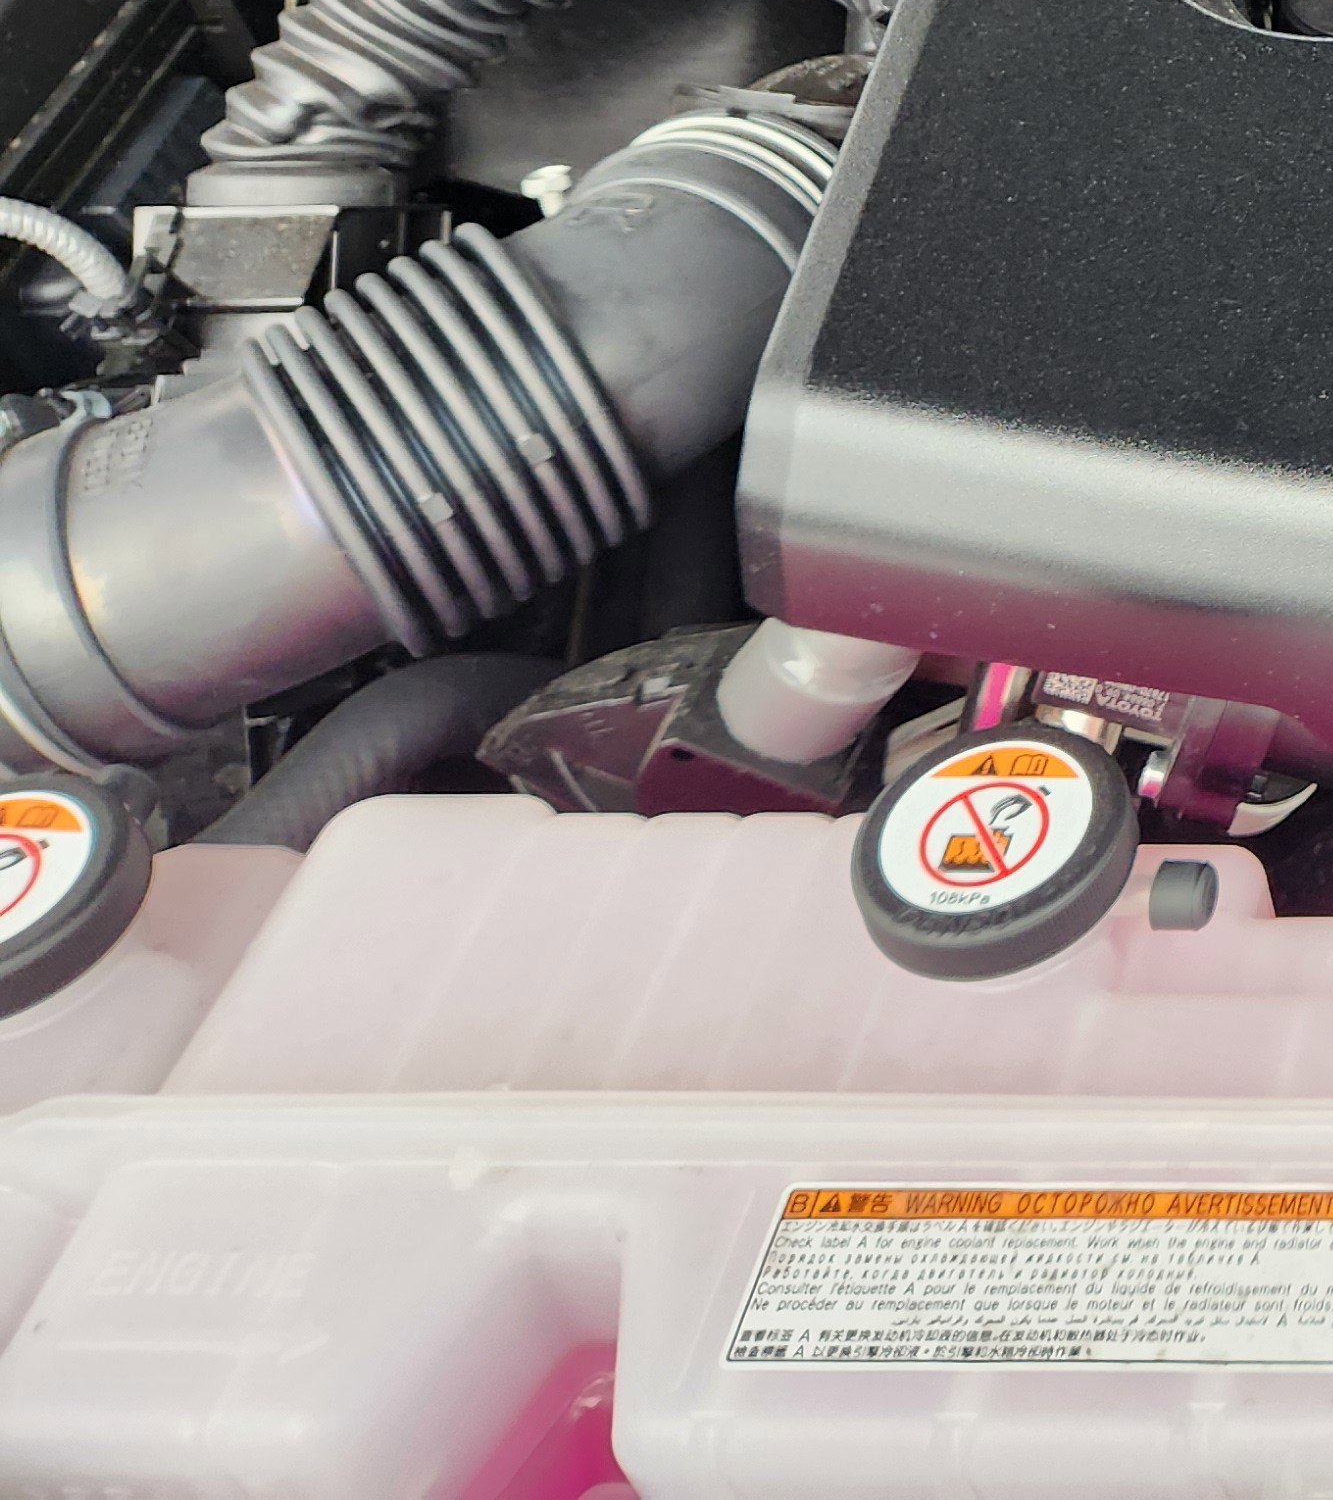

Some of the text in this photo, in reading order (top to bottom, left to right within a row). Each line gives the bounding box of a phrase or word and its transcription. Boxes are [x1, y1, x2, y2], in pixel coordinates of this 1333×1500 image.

[1096, 692, 1164, 721] TOYOTA
[789, 1193, 809, 1213] B
[905, 1192, 1003, 1214] WARNING
[1017, 1192, 1155, 1214] ОСТОРОЖНО
[1166, 1193, 1333, 1215] AVERTISSEMENT
[774, 1236, 813, 1248] Check
[820, 1236, 851, 1248] label
[857, 1236, 867, 1248] A
[875, 1236, 894, 1248] for
[901, 1237, 941, 1250] engine
[948, 1237, 996, 1249] coolant
[1087, 1236, 1120, 1248] Work
[1127, 1237, 1160, 1249] when
[1167, 1237, 1187, 1249] the
[1195, 1237, 1235, 1250] engine
[1242, 1237, 1268, 1250] and
[1274, 1238, 1322, 1250] radiator
[92, 1251, 318, 1298] ENGINE
[757, 1282, 823, 1296] Consulter
[904, 1282, 914, 1295] A
[923, 1284, 956, 1296] pour
[963, 1282, 976, 1295] le
[984, 1282, 1077, 1296] remplacement
[1085, 1282, 1103, 1295] du
[1111, 1282, 1156, 1296] liquide
[1164, 1282, 1181, 1295] de
[1189, 1281, 1292, 1296] refroidissement
[1301, 1283, 1318, 1295] du
[750, 1298, 769, 1310] Ne
[776, 1297, 837, 1312] procéder
[845, 1301, 865, 1311] au
[872, 1299, 966, 1312] remplacement
[973, 1301, 1000, 1311] que
[1007, 1298, 1058, 1311] lorsque
[1066, 1298, 1078, 1311] le
[1087, 1299, 1134, 1311] moteur
[1142, 1299, 1155, 1311] et
[1164, 1298, 1176, 1311] le
[1184, 1298, 1246, 1311] radiateur
[1254, 1299, 1284, 1311] sont
[798, 1329, 810, 1342] A
[793, 1345, 804, 1358] A
